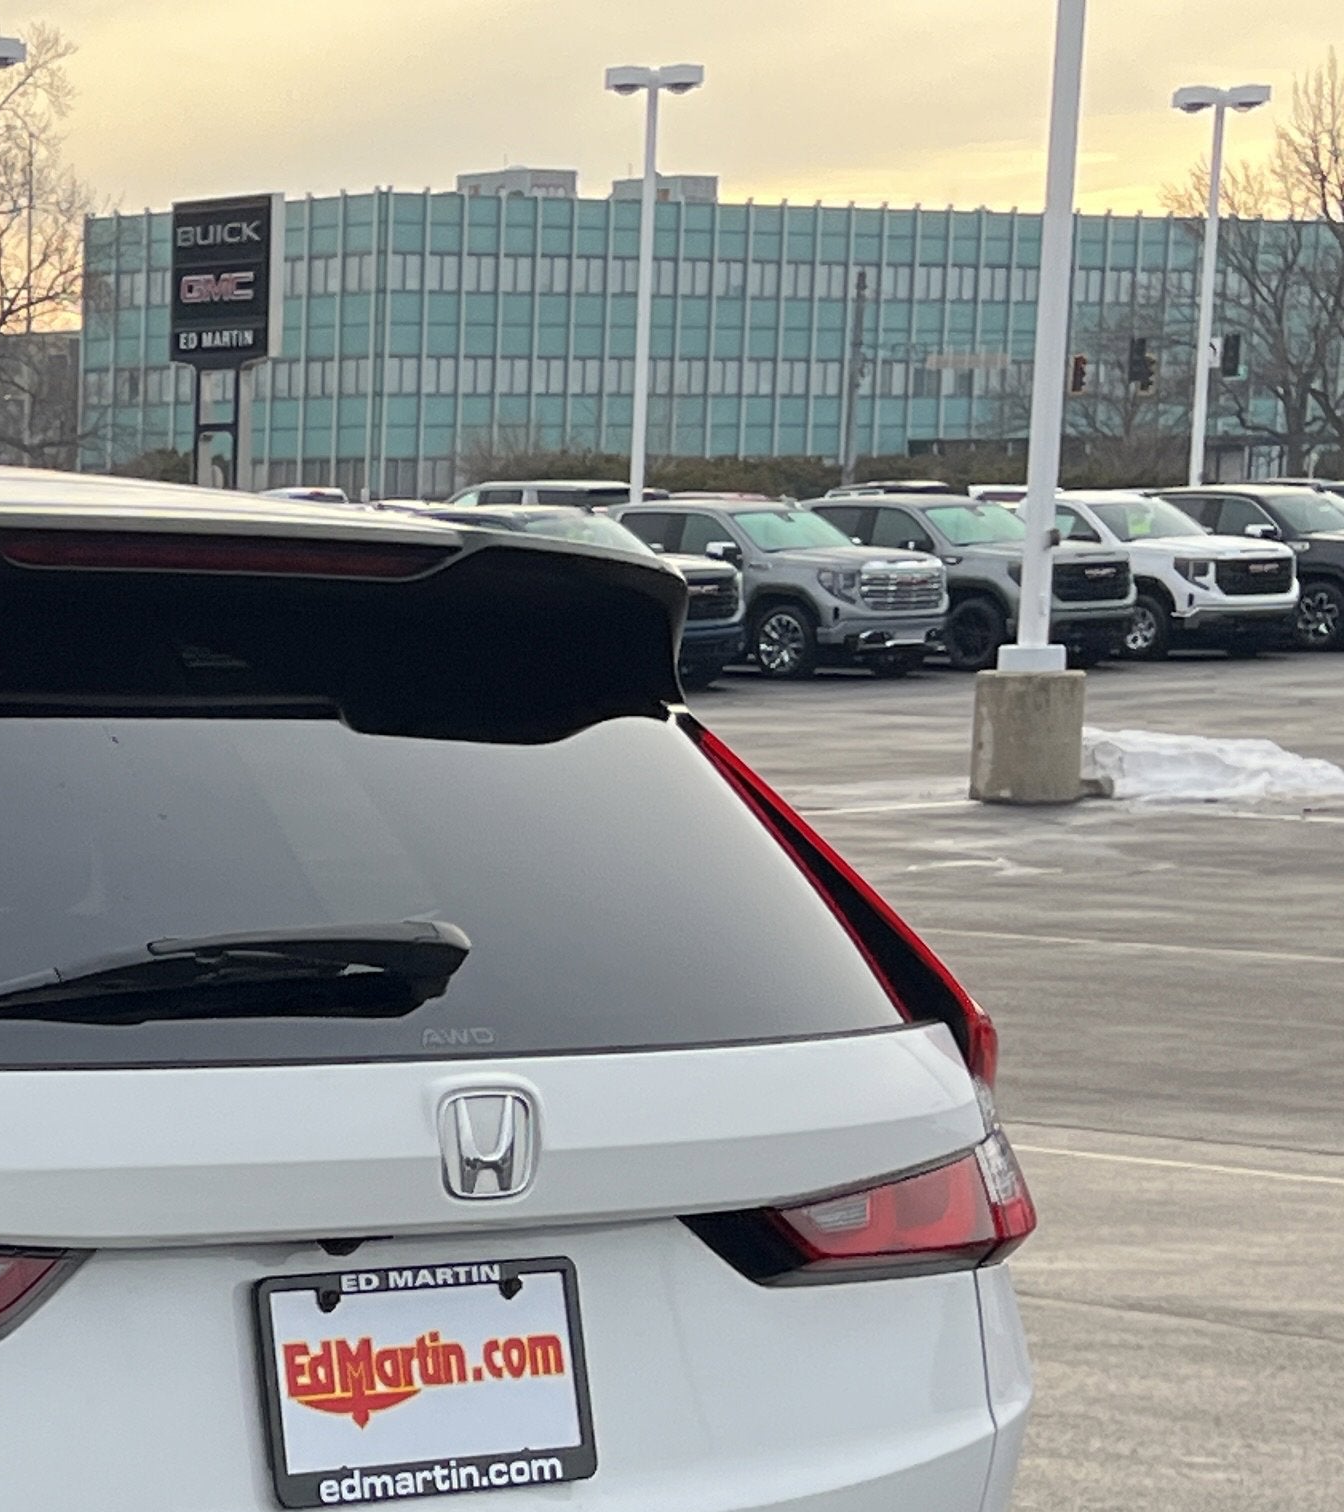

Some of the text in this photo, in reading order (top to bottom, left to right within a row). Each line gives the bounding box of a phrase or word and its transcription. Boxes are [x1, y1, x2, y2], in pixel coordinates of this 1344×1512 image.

[175, 220, 262, 248] BUICK
[179, 271, 255, 304] GMC
[178, 329, 254, 350] ED MARTIN
[422, 1026, 496, 1048] AWD
[340, 1263, 501, 1293] ED MARTIN
[282, 1330, 565, 1399] EdMartin.com
[319, 1454, 564, 1504] edmartin.com
